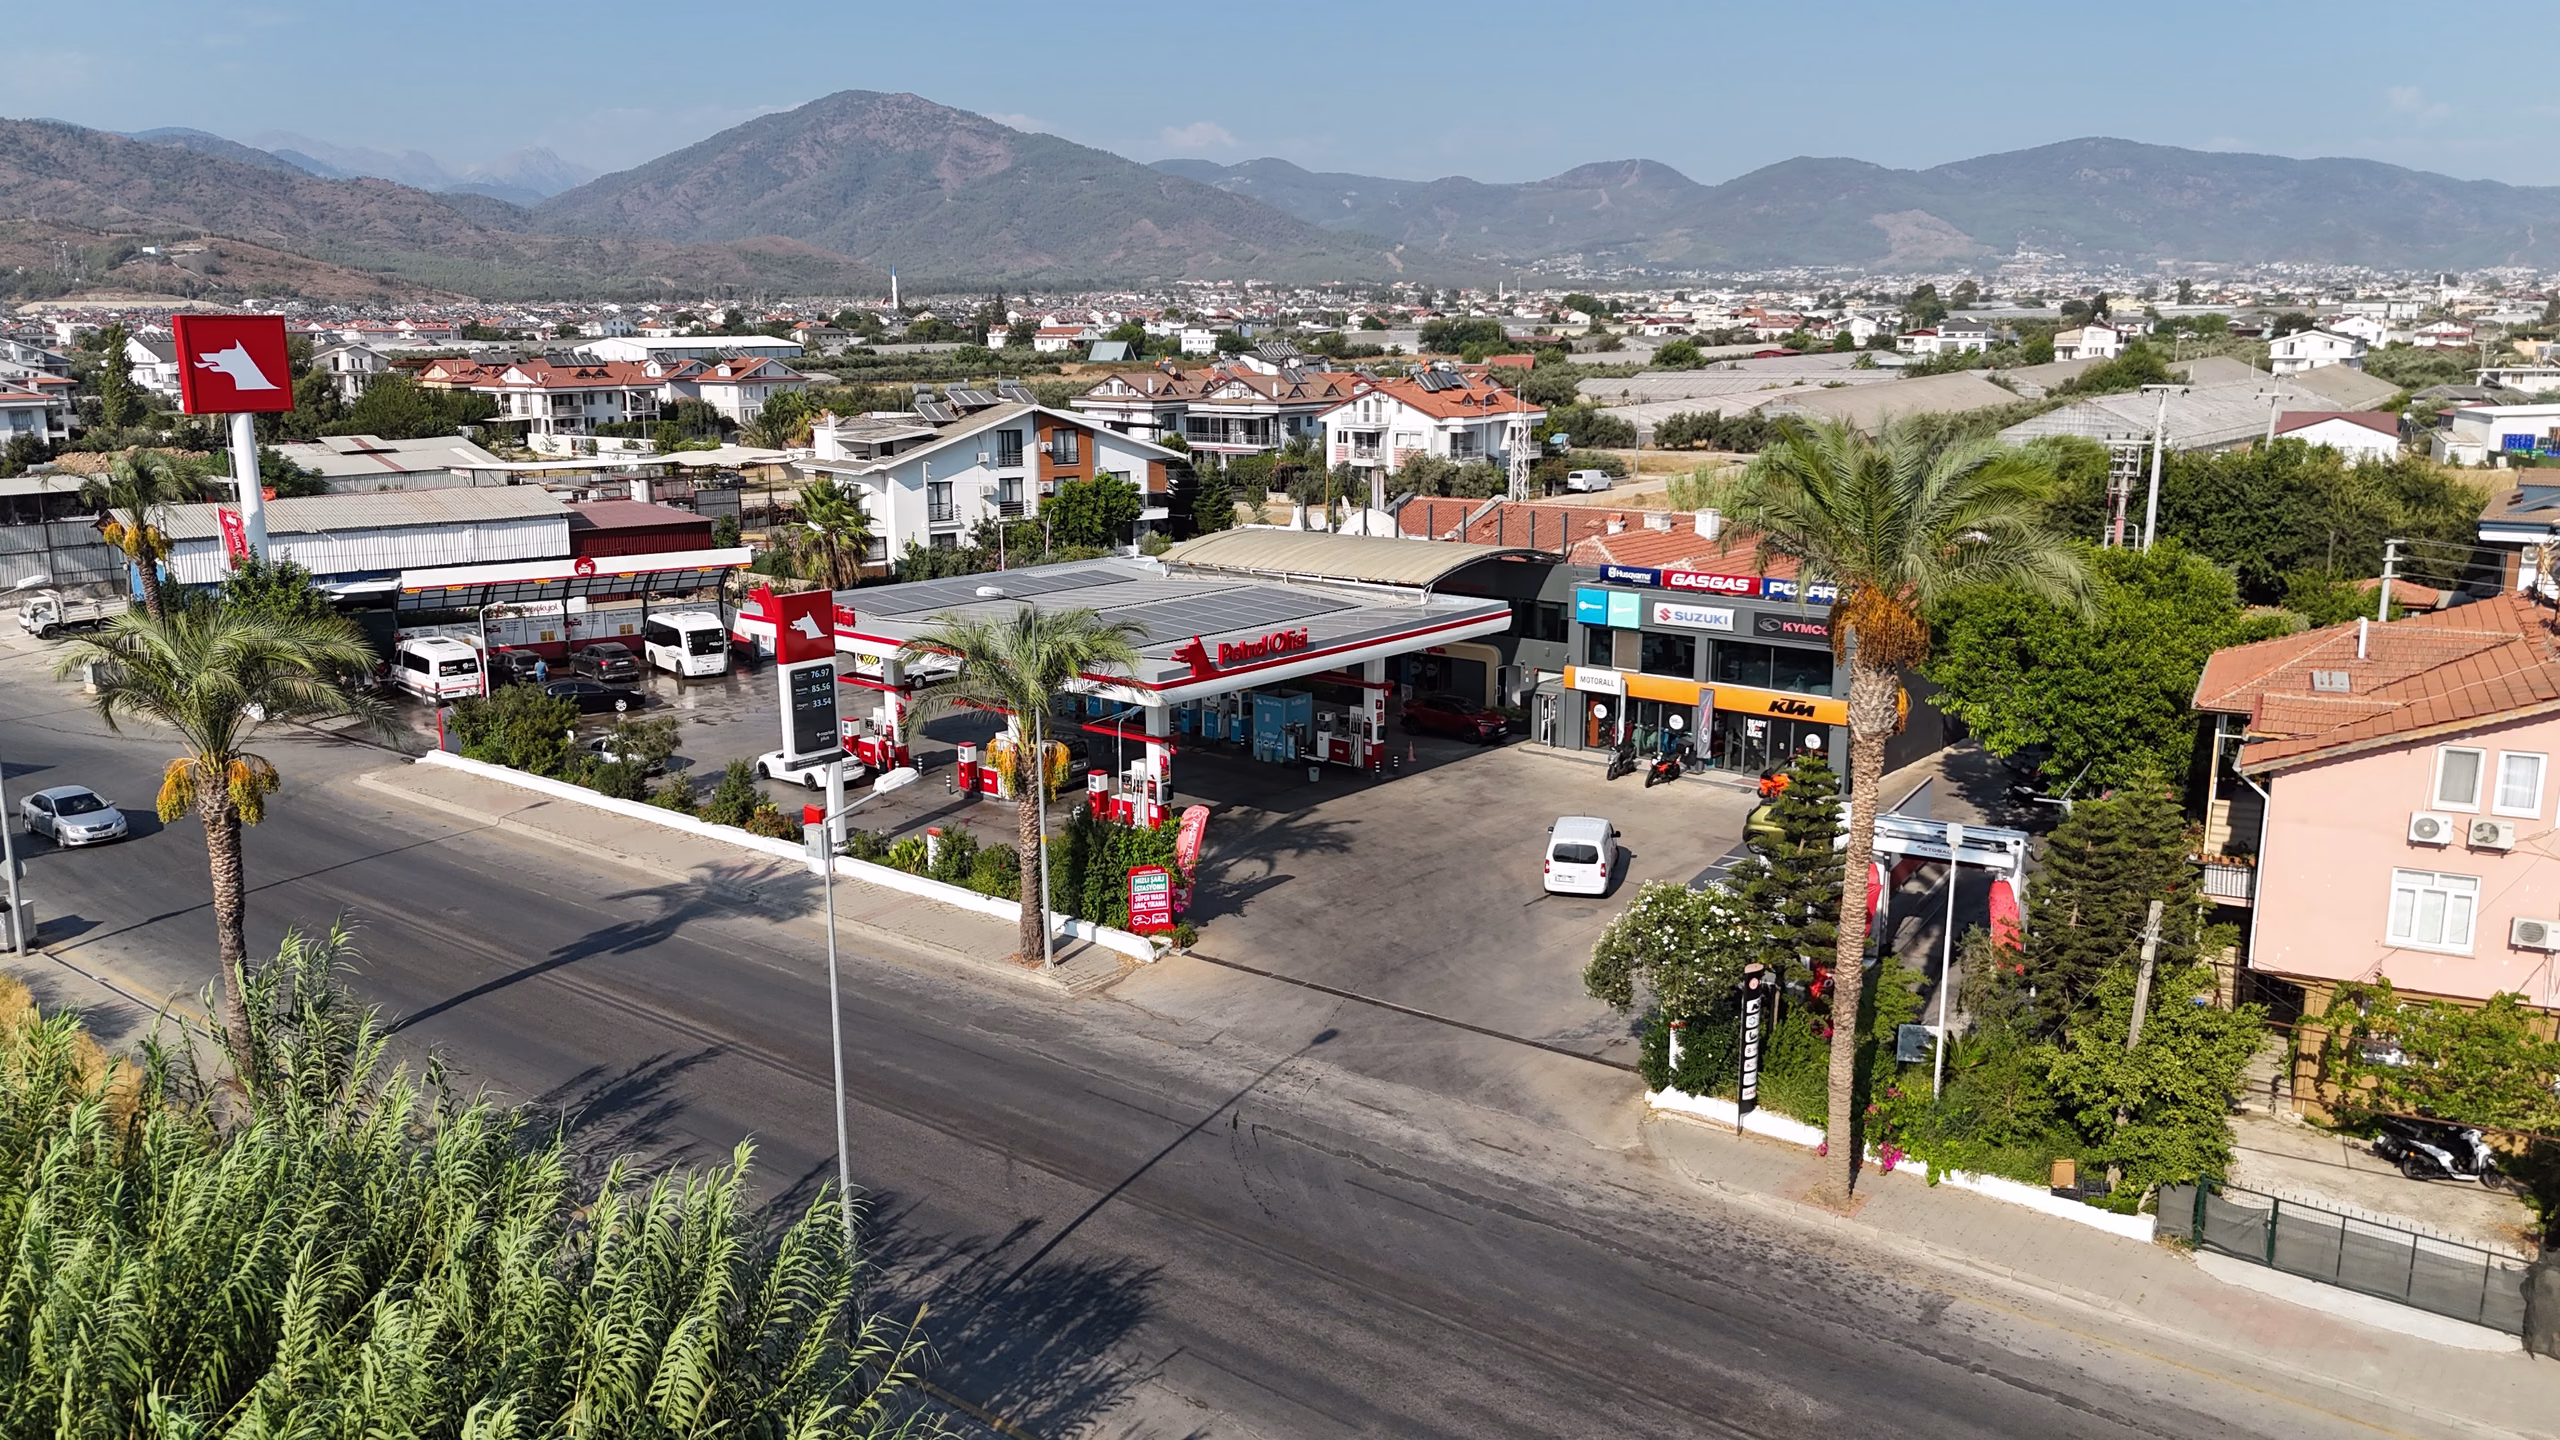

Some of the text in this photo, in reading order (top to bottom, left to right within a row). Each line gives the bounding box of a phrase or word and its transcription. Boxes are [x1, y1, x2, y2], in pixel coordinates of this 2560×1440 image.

[1616, 569, 1652, 580] Husqvarna
[1671, 573, 1750, 591] GASGAS
[1674, 611, 1728, 625] SUZUKI
[1218, 627, 1308, 665] Petrol Ofisi
[811, 668, 830, 679] 76.97
[1580, 675, 1615, 687] MOTORALL
[811, 682, 831, 693] 85.56
[812, 697, 832, 708] 33.54
[1768, 698, 1816, 717] KTM
